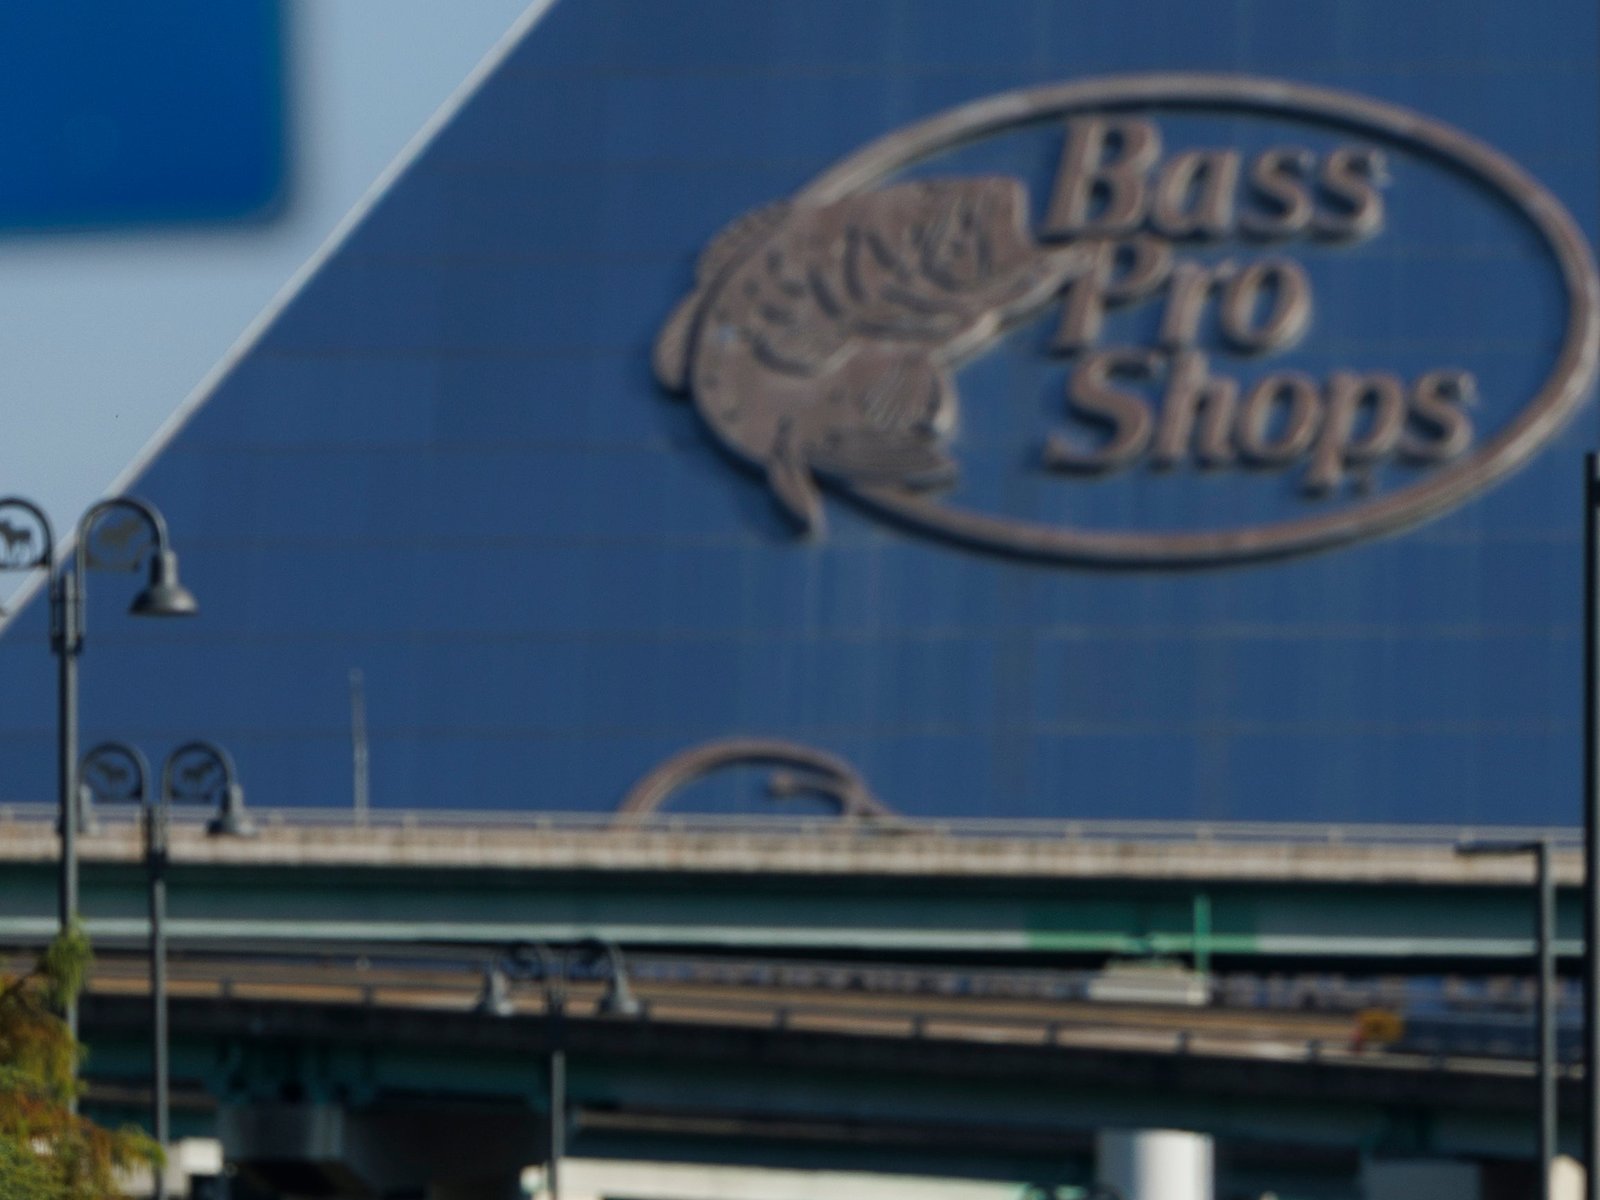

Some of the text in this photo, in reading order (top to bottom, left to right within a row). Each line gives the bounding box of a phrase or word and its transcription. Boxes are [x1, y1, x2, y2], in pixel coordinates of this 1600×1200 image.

[1038, 116, 1389, 241] Bass
[1050, 238, 1314, 357] Pro
[1043, 347, 1478, 495] Shops
